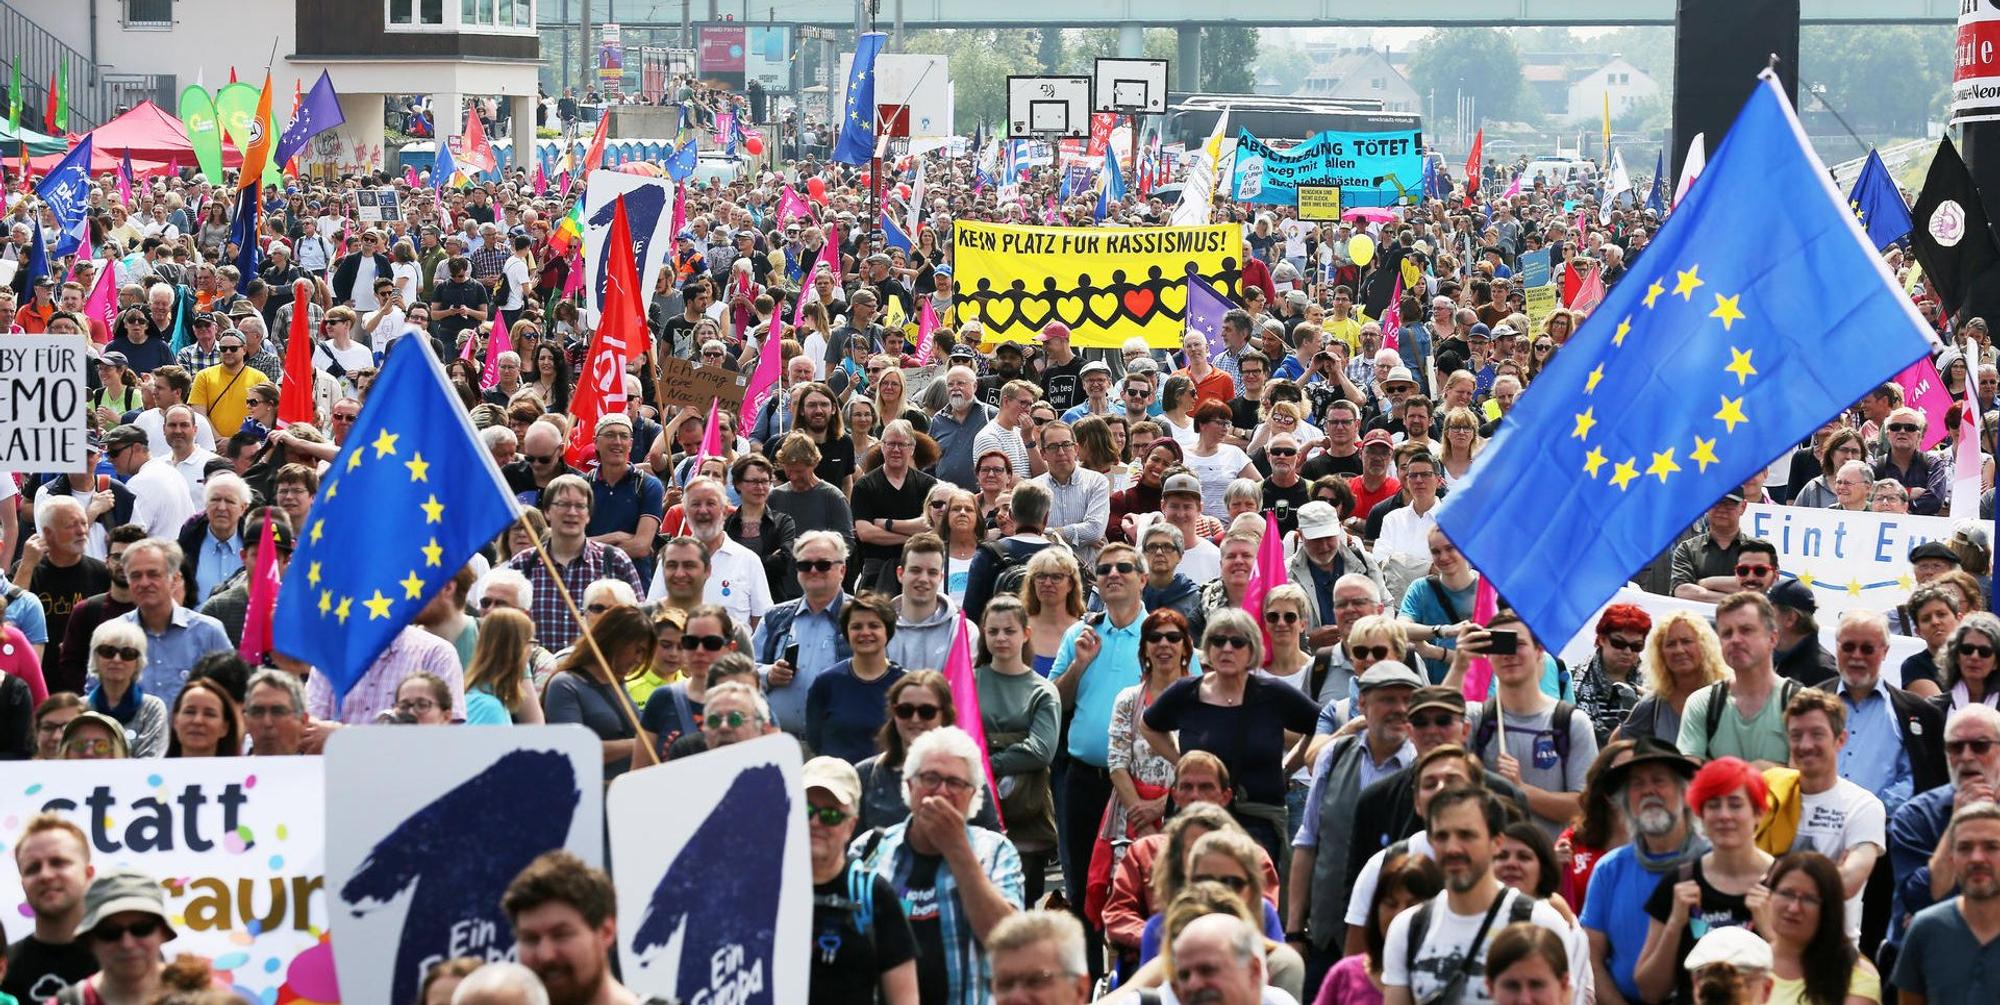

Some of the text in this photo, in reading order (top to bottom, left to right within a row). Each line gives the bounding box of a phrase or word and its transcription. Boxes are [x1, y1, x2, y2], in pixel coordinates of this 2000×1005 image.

[1267, 157, 1355, 178] weg mit allen
[959, 227, 996, 252] KEIN
[1002, 232, 1056, 254] PLATZ
[1106, 230, 1227, 254] RASSISMUS!
[36, 345, 76, 374] FÜR
[668, 360, 727, 389] Ich mag
[0, 428, 77, 462] ATIE
[448, 918, 496, 959] Ein
[711, 944, 744, 990] Ein
